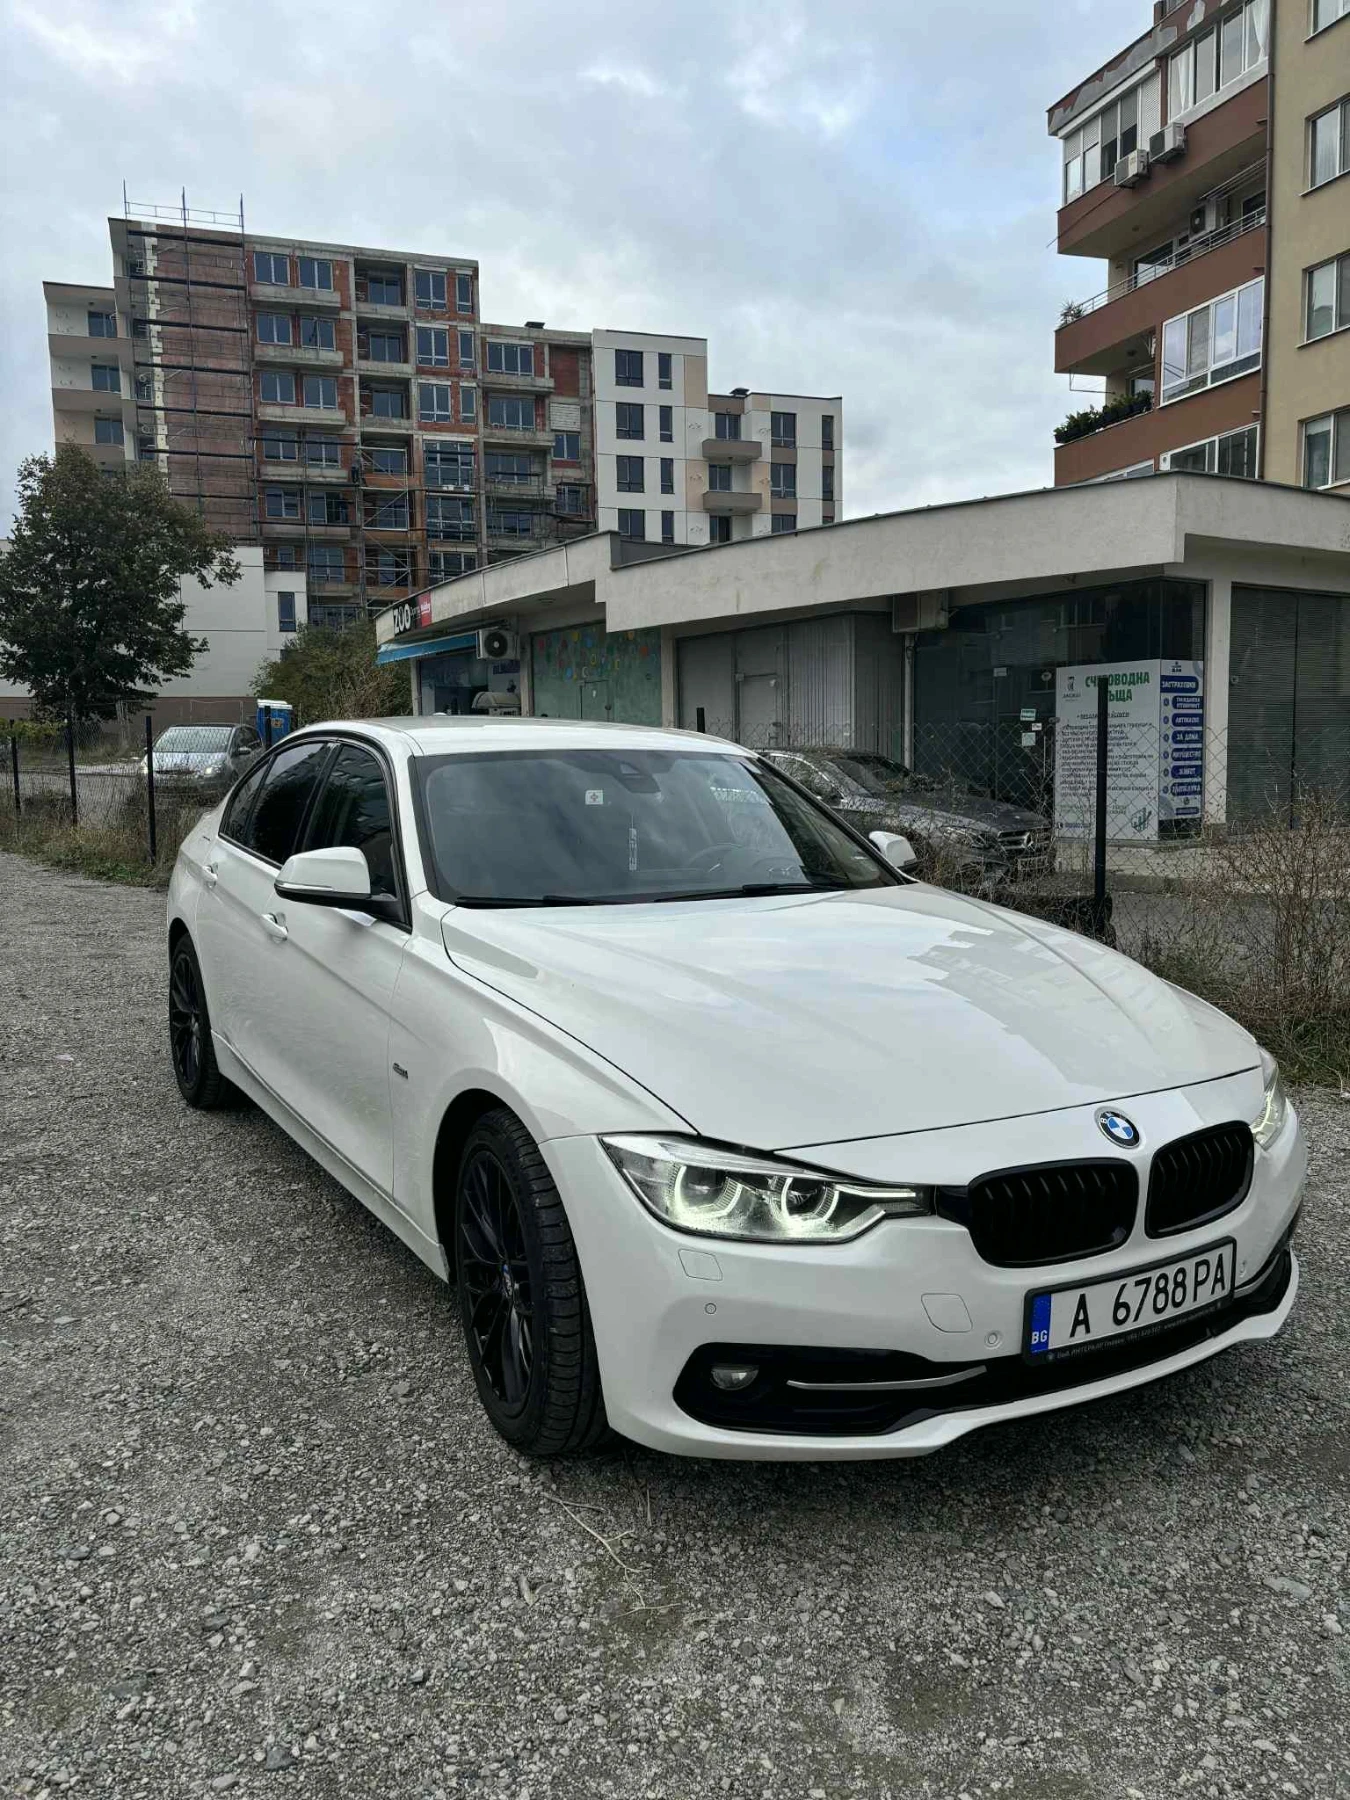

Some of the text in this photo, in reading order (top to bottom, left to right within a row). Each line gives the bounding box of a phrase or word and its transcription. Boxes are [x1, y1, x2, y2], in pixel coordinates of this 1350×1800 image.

[394, 604, 411, 633] ZOO
[1085, 672, 1150, 687] СЧОВОДНА
[1105, 688, 1132, 702] ЪЩА
[1069, 1293, 1091, 1338] A
[1113, 1267, 1187, 1326] 6788
[1193, 1253, 1226, 1302] PA
[1031, 1329, 1048, 1345] BG
